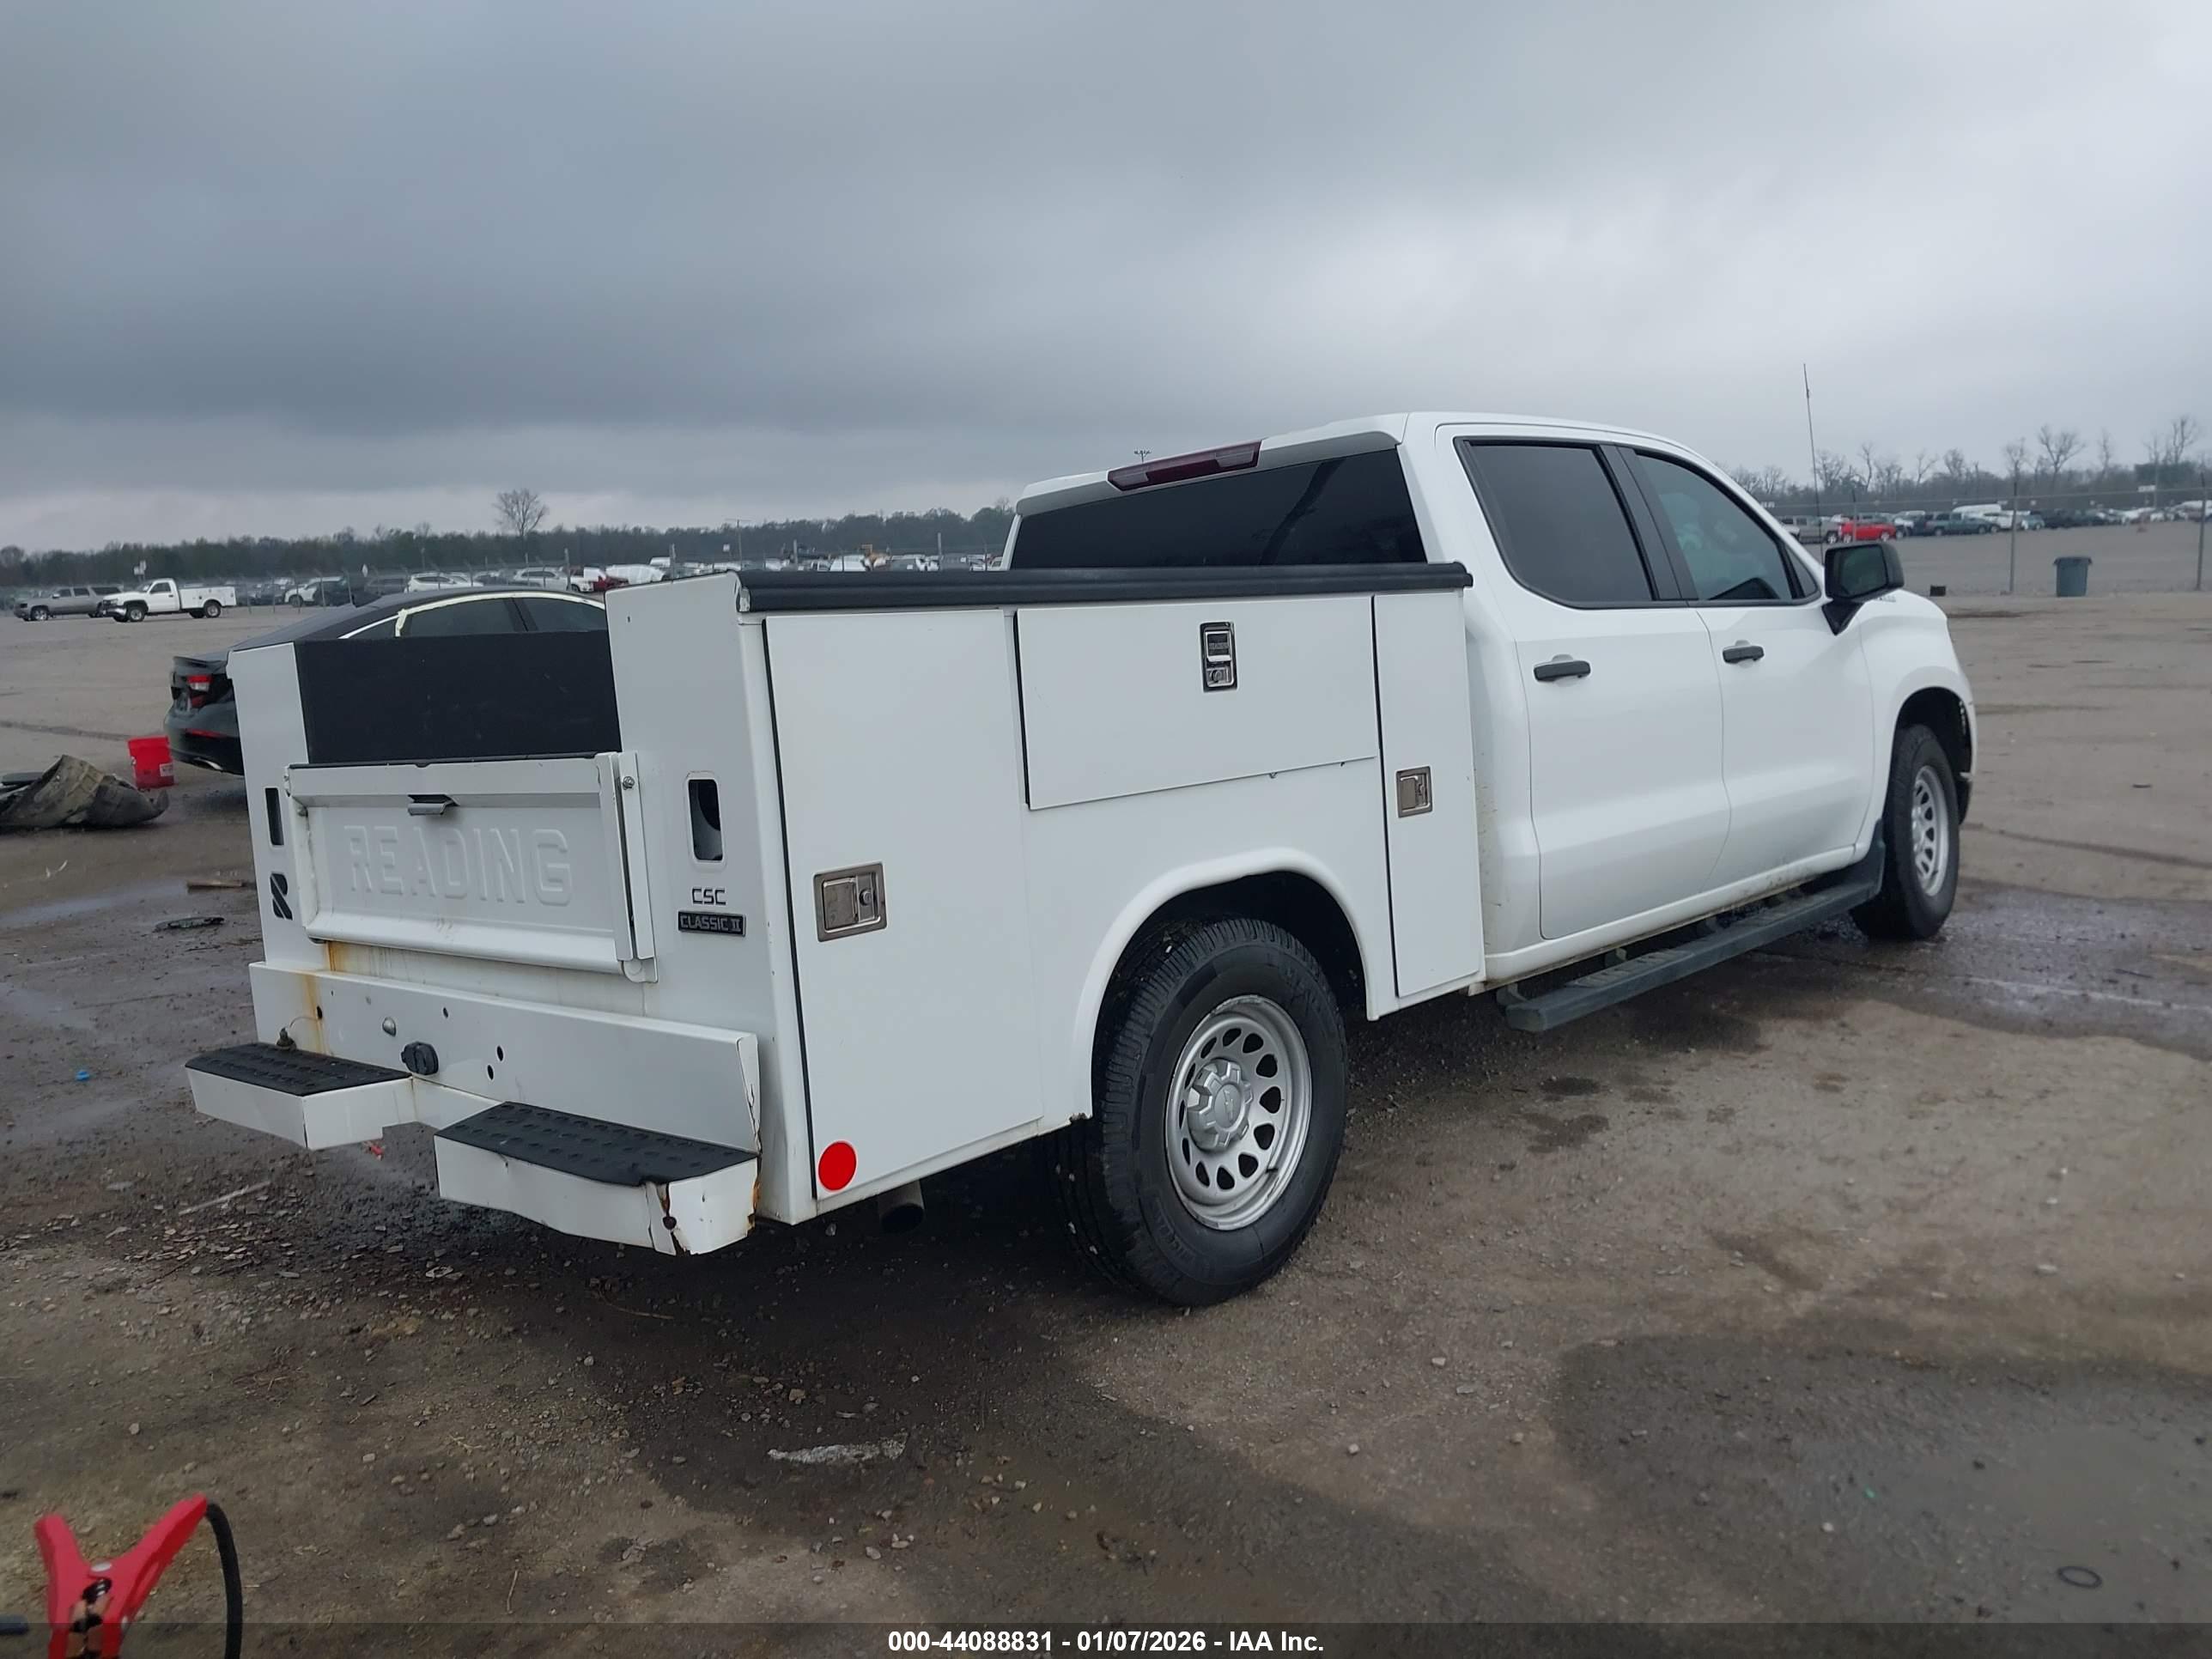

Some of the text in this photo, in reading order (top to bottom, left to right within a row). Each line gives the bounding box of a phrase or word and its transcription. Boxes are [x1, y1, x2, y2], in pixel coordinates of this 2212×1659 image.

[343, 825, 573, 907] READING
[691, 888, 726, 905] CSC
[679, 915, 729, 931] CLASSIC
